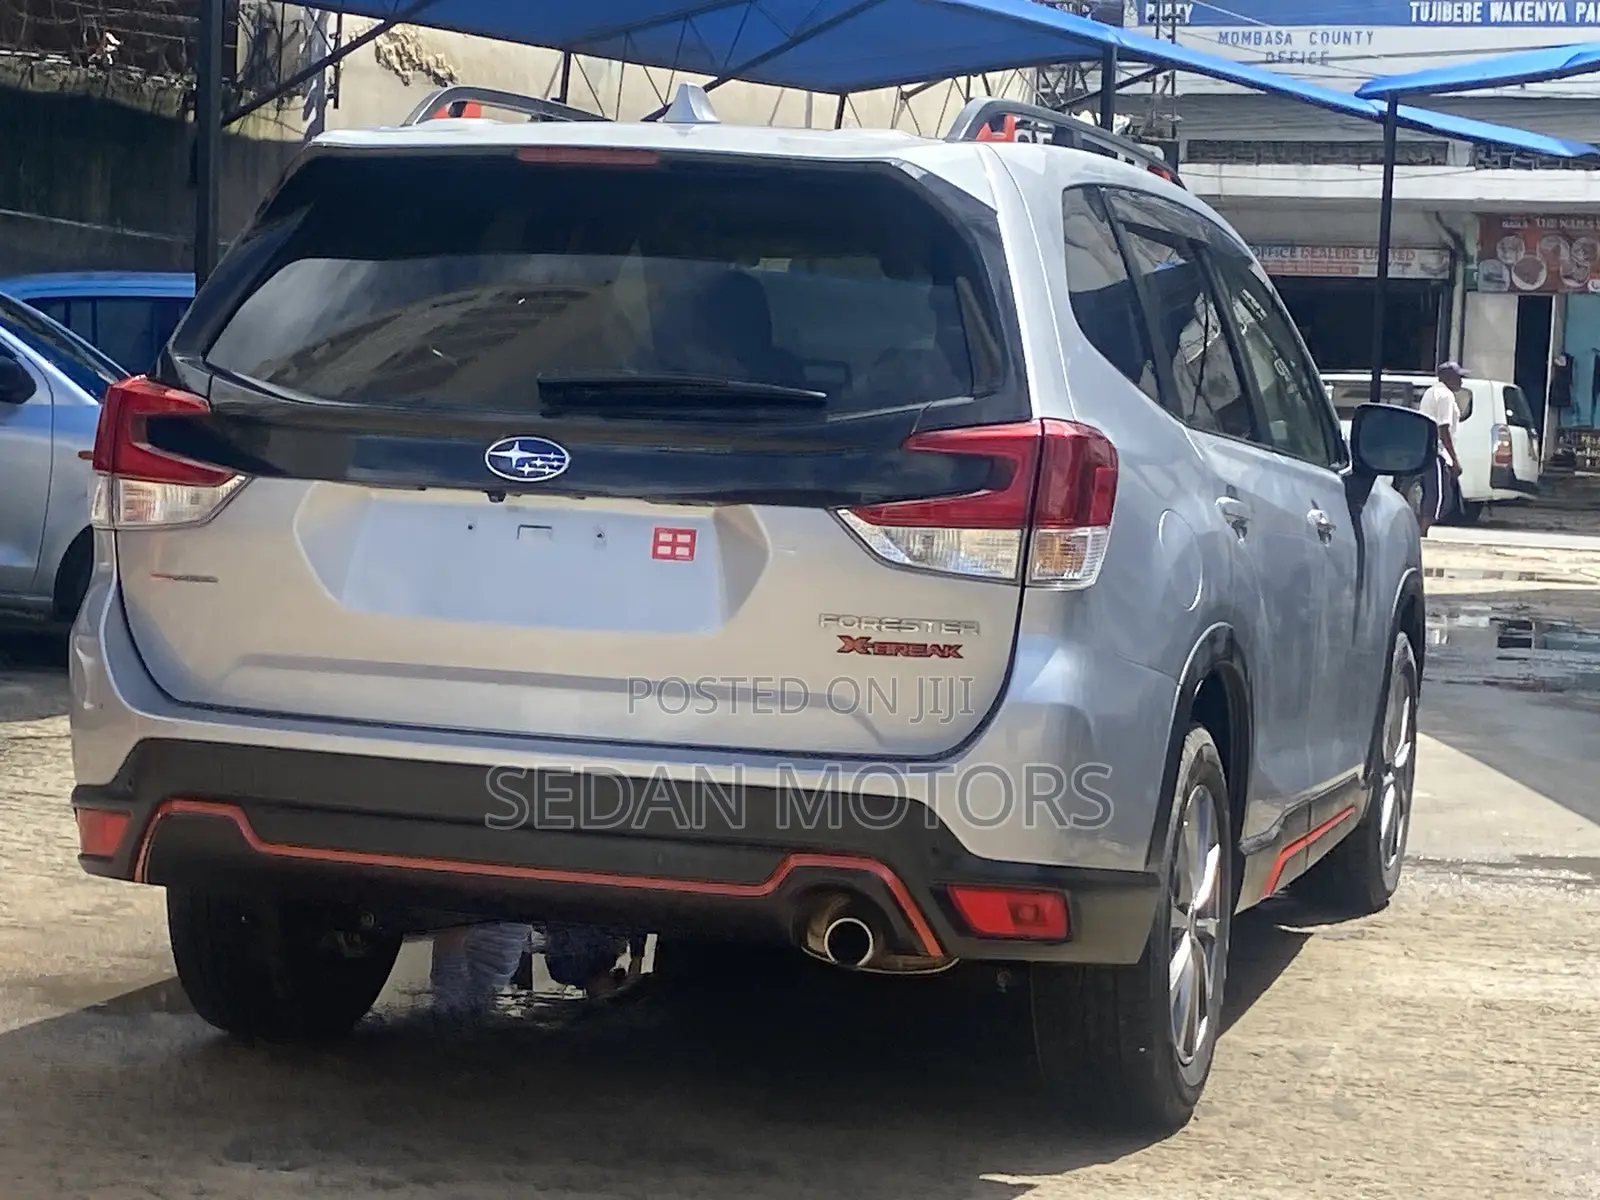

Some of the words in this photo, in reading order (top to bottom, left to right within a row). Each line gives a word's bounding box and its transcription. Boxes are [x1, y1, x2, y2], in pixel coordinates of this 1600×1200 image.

[1410, 1, 1483, 23] TUJIBEBE
[1490, 1, 1566, 23] WAKENYA
[1218, 31, 1293, 46] MOMBASA
[1309, 31, 1374, 46] COUNTY
[1265, 51, 1330, 66] OFFICE
[818, 612, 981, 636] FORESTER
[836, 635, 964, 659] X-BREAK
